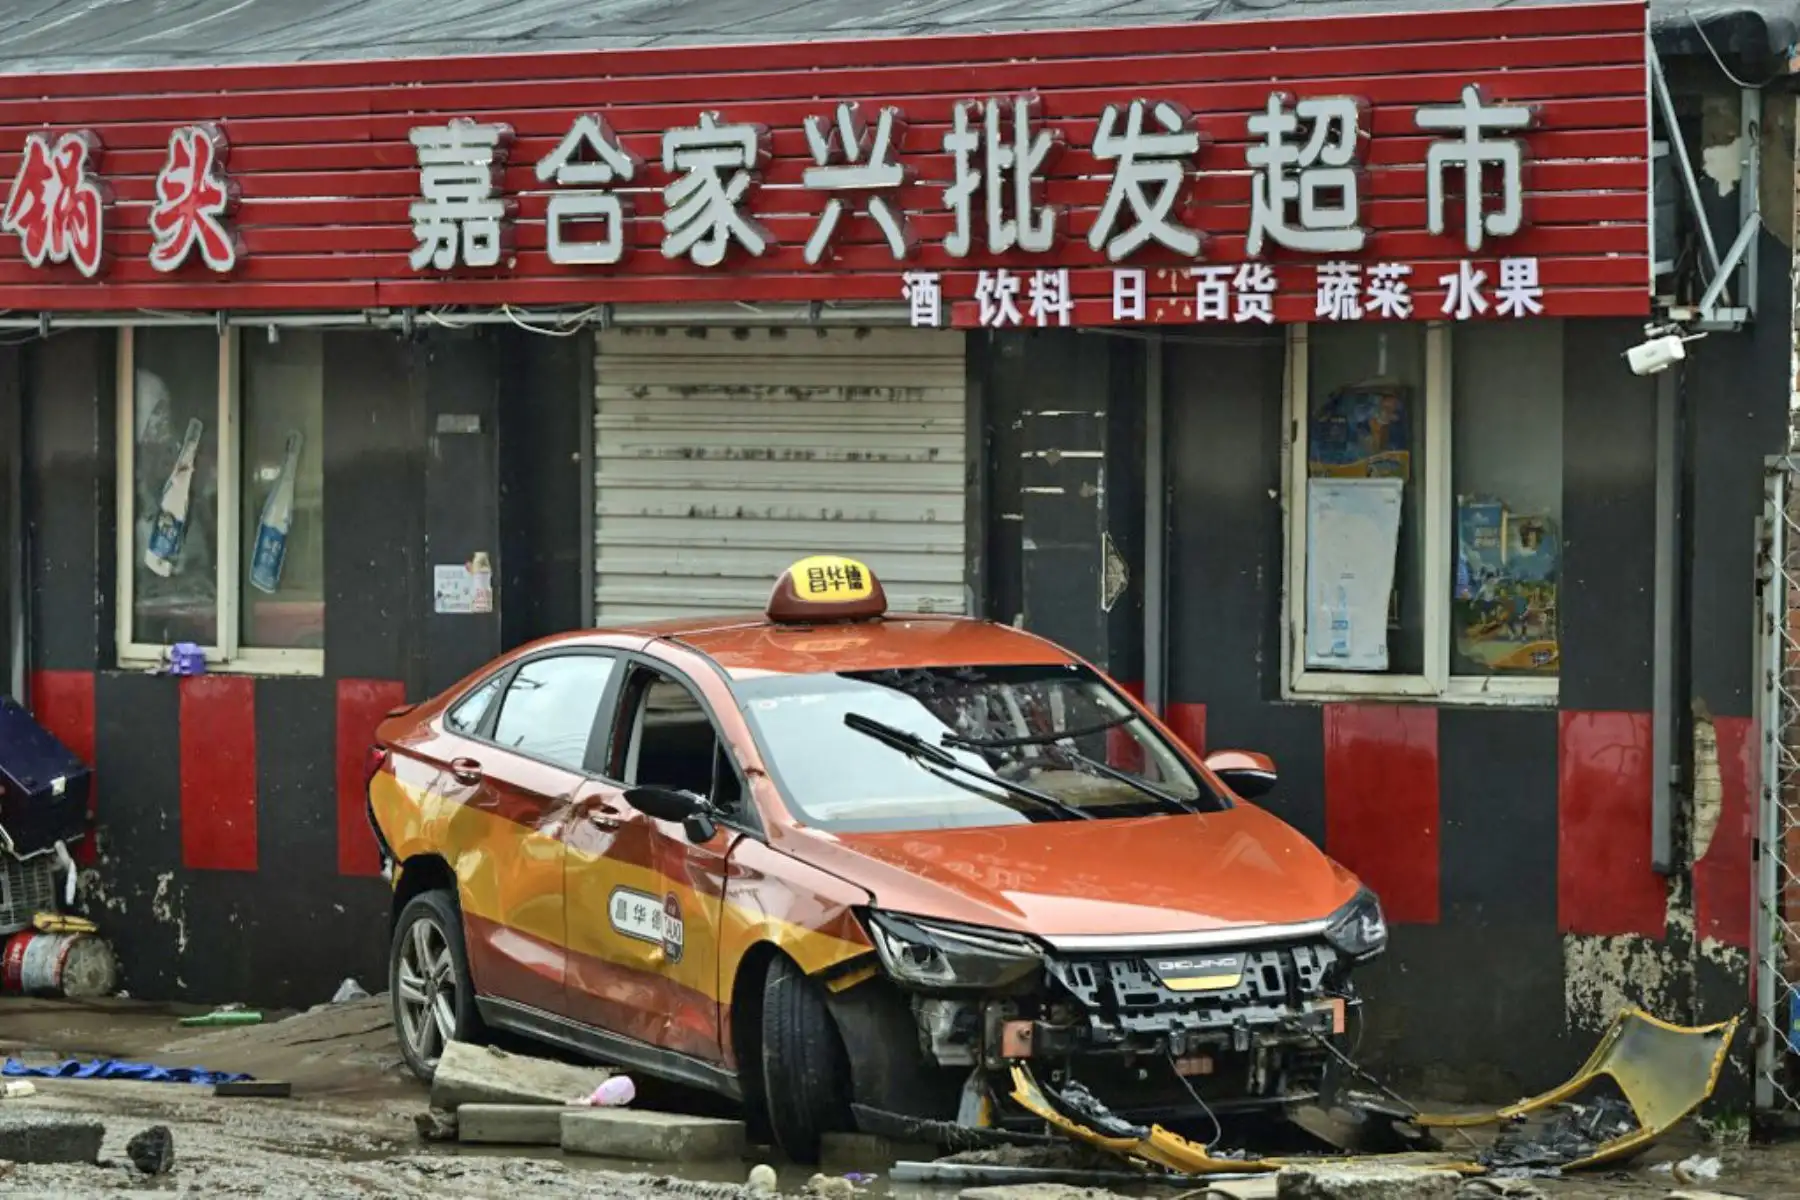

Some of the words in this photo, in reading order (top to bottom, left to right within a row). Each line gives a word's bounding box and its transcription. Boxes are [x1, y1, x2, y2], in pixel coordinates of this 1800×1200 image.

[408, 84, 1532, 273] 嘉合家兴批发超市
[902, 271, 942, 327] 酒
[974, 268, 1074, 327] 饮料
[1191, 263, 1277, 324] 百货
[1315, 260, 1413, 321] 蔬菜
[1439, 256, 1543, 320] 水果
